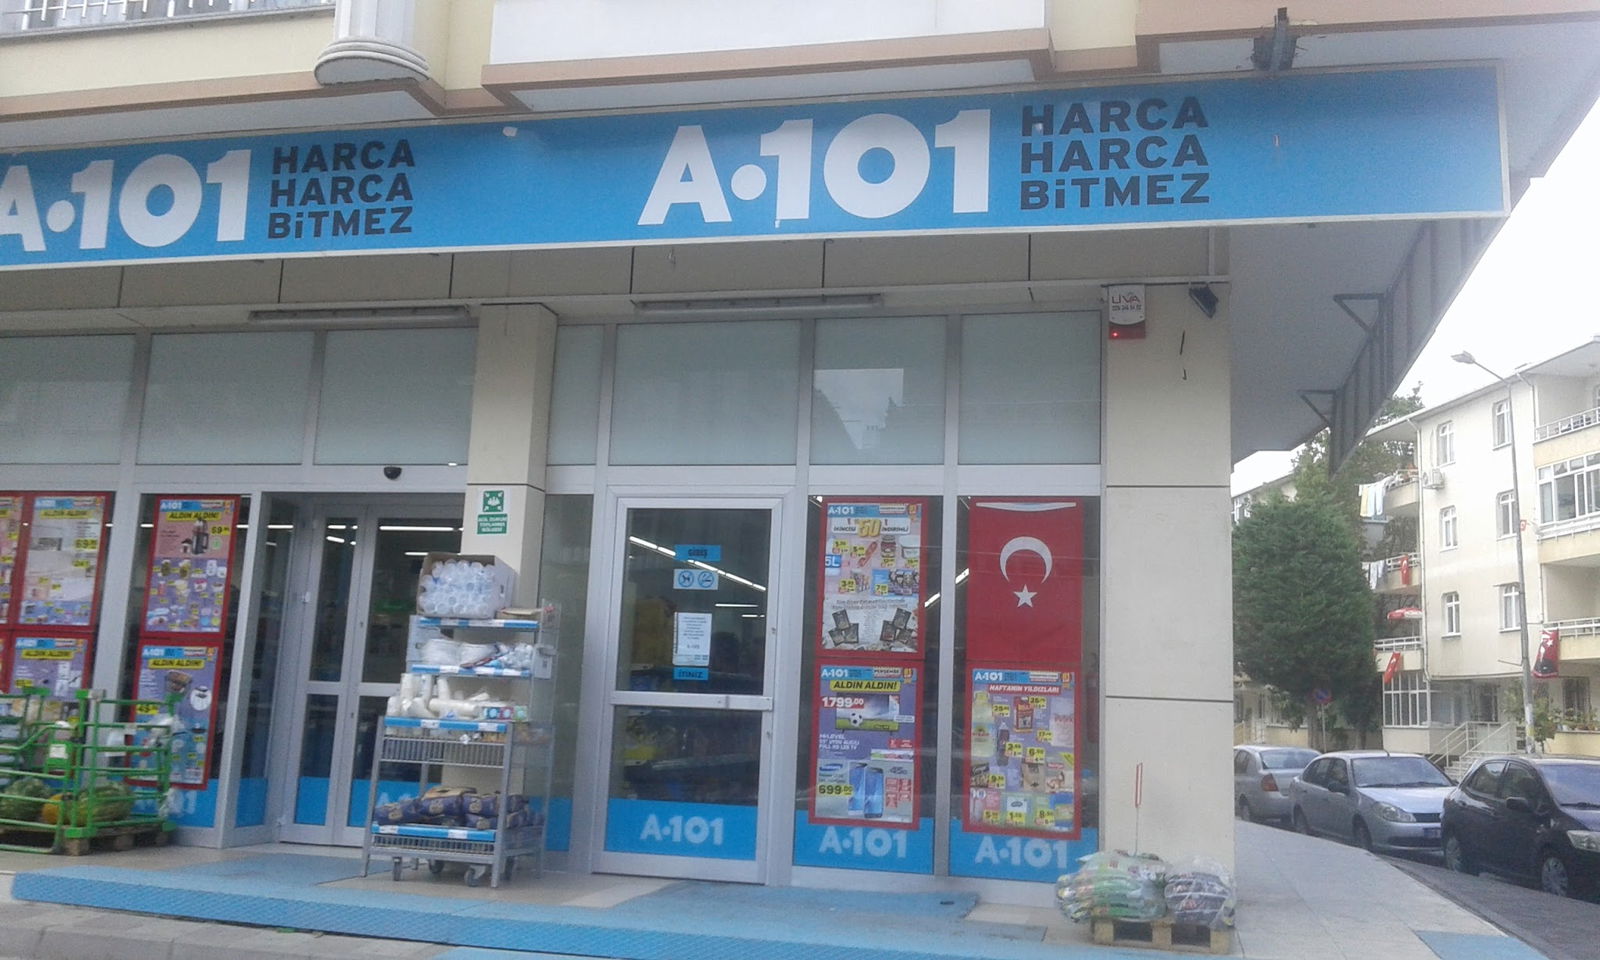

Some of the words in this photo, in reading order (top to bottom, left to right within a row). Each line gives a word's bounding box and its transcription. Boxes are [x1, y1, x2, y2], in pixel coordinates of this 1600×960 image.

[1021, 96, 1209, 137] HARCA
[271, 139, 416, 175] HARCA
[1020, 133, 1209, 174] HARCA
[270, 172, 414, 207] HARCA
[833, 680, 863, 689] ALDIN
[864, 682, 898, 690] ALDIN!
